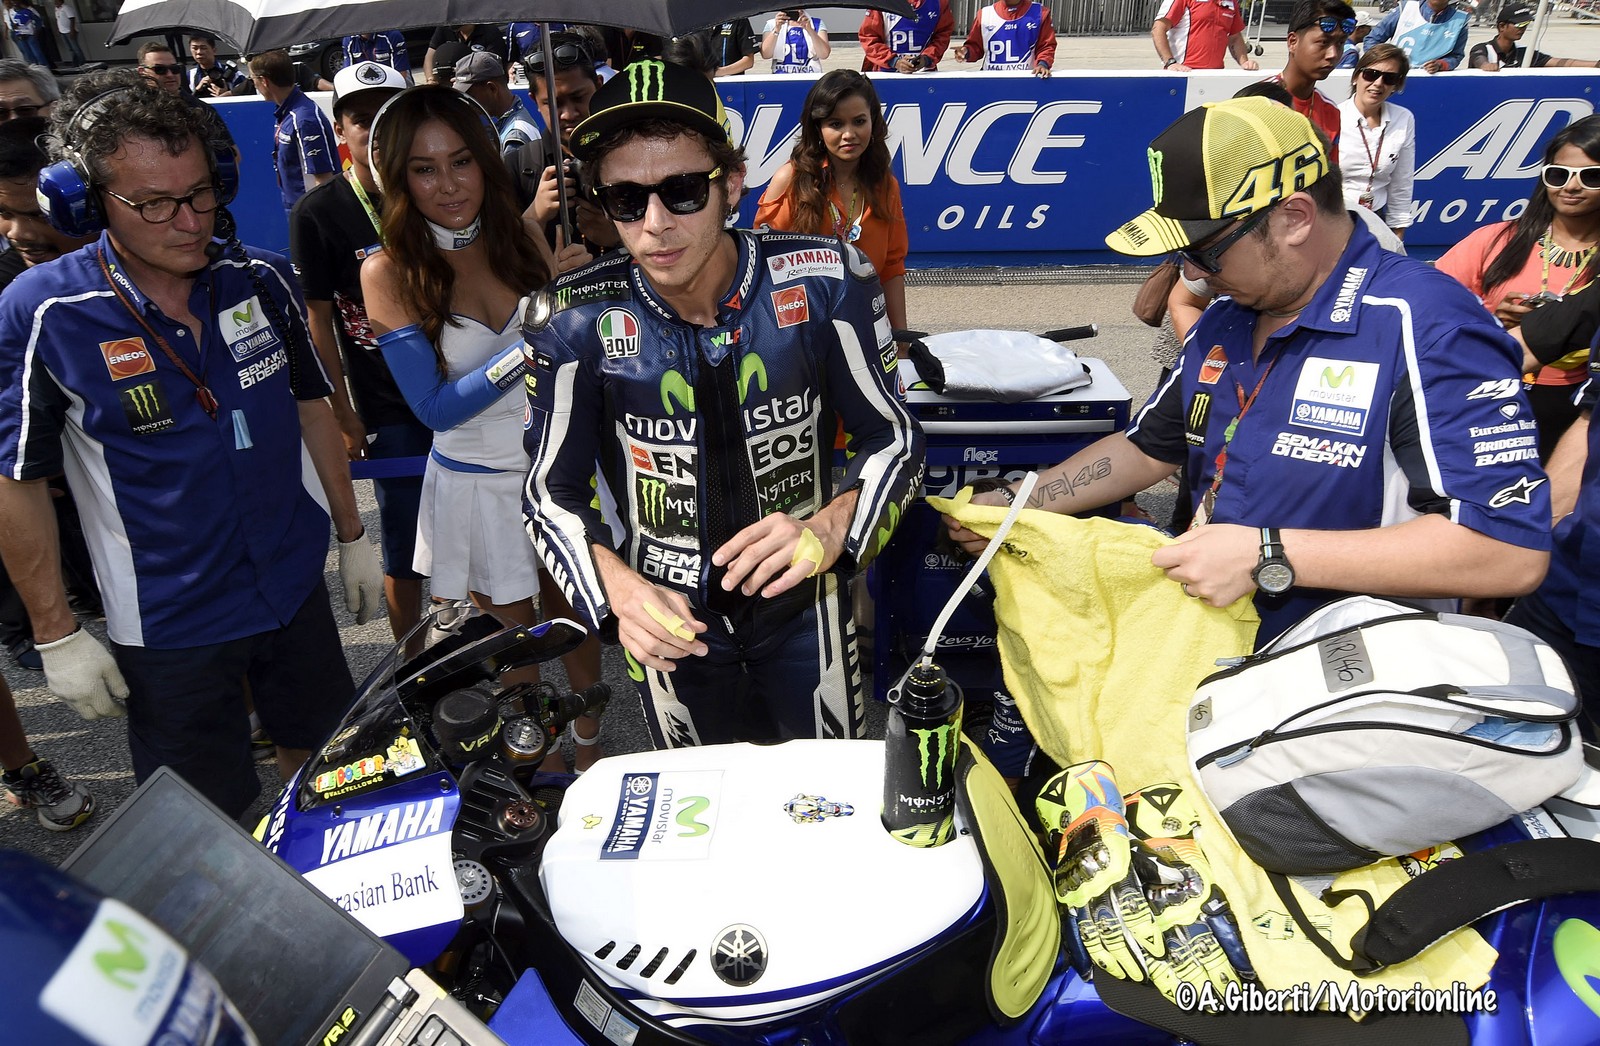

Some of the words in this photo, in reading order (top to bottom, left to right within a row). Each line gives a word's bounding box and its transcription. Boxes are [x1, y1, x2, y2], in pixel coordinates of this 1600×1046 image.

[892, 30, 922, 52] PL
[990, 39, 1020, 62] PL
[1220, 142, 1325, 220] 46
[936, 204, 1051, 231] OILS
[785, 249, 843, 268] YAMAHA
[571, 280, 630, 297] MONSTER
[777, 299, 805, 314] ENEOS
[605, 336, 637, 358] agv
[710, 327, 742, 348] WLF
[109, 350, 147, 366] ENEOS
[1311, 405, 1362, 427] YAMAHA
[1469, 421, 1520, 438] Eurasian
[964, 447, 998, 465] flex
[1277, 432, 1368, 458] SEMAKIN
[1293, 448, 1363, 469] DEPAN
[1193, 704, 1208, 721] 46
[336, 754, 386, 788] DOCTOR
[611, 796, 650, 853] YAMAHA
[651, 788, 674, 844] movistar
[319, 797, 445, 866] YAMAHA
[391, 865, 440, 902] Bank
